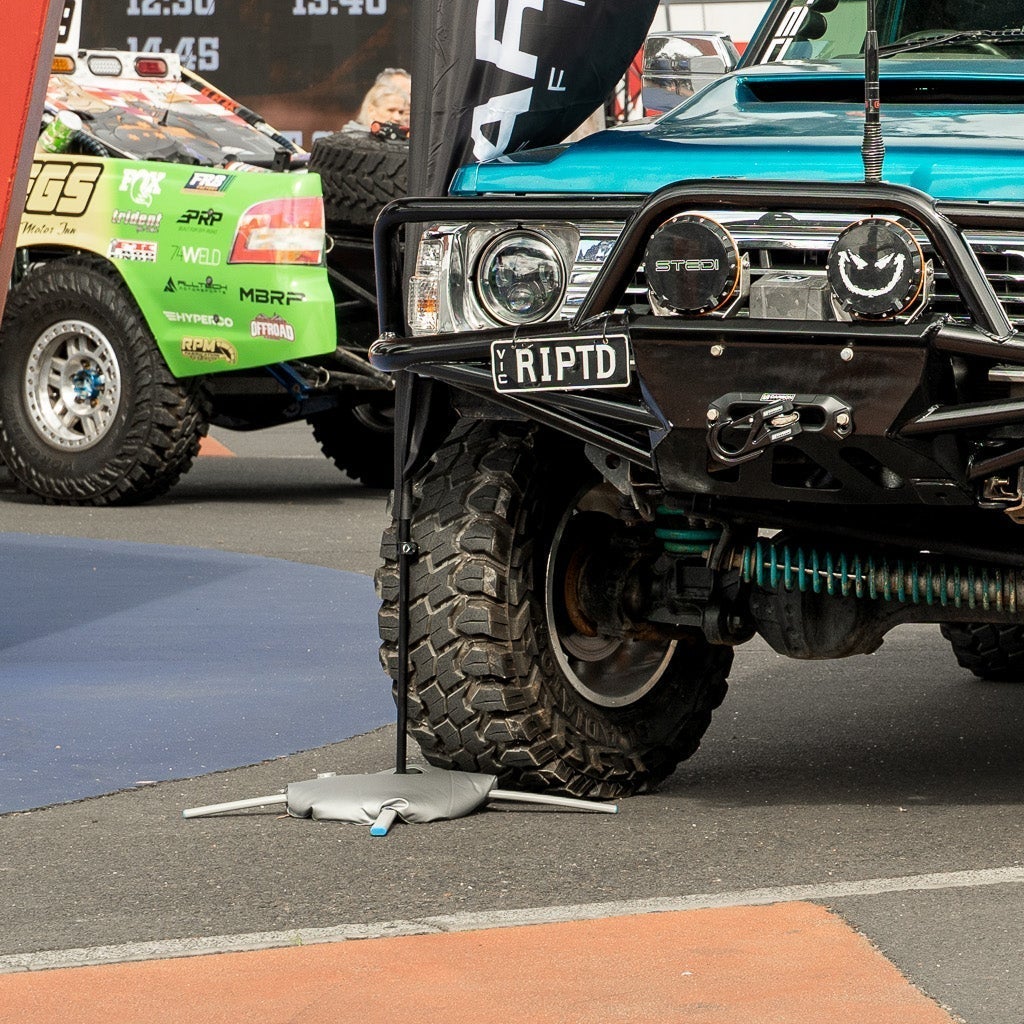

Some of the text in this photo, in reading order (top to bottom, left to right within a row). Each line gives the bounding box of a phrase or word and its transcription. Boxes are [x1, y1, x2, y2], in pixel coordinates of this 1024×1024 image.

[119, 168, 166, 205] FOX
[112, 209, 163, 227] trident
[177, 208, 223, 226] PRP
[655, 258, 719, 272] STEDI
[240, 287, 306, 306] MBRP
[251, 320, 294, 342] OFFROAD
[182, 337, 216, 353] RPM
[496, 349, 508, 385] VIC
[516, 344, 617, 383] RIPTD
